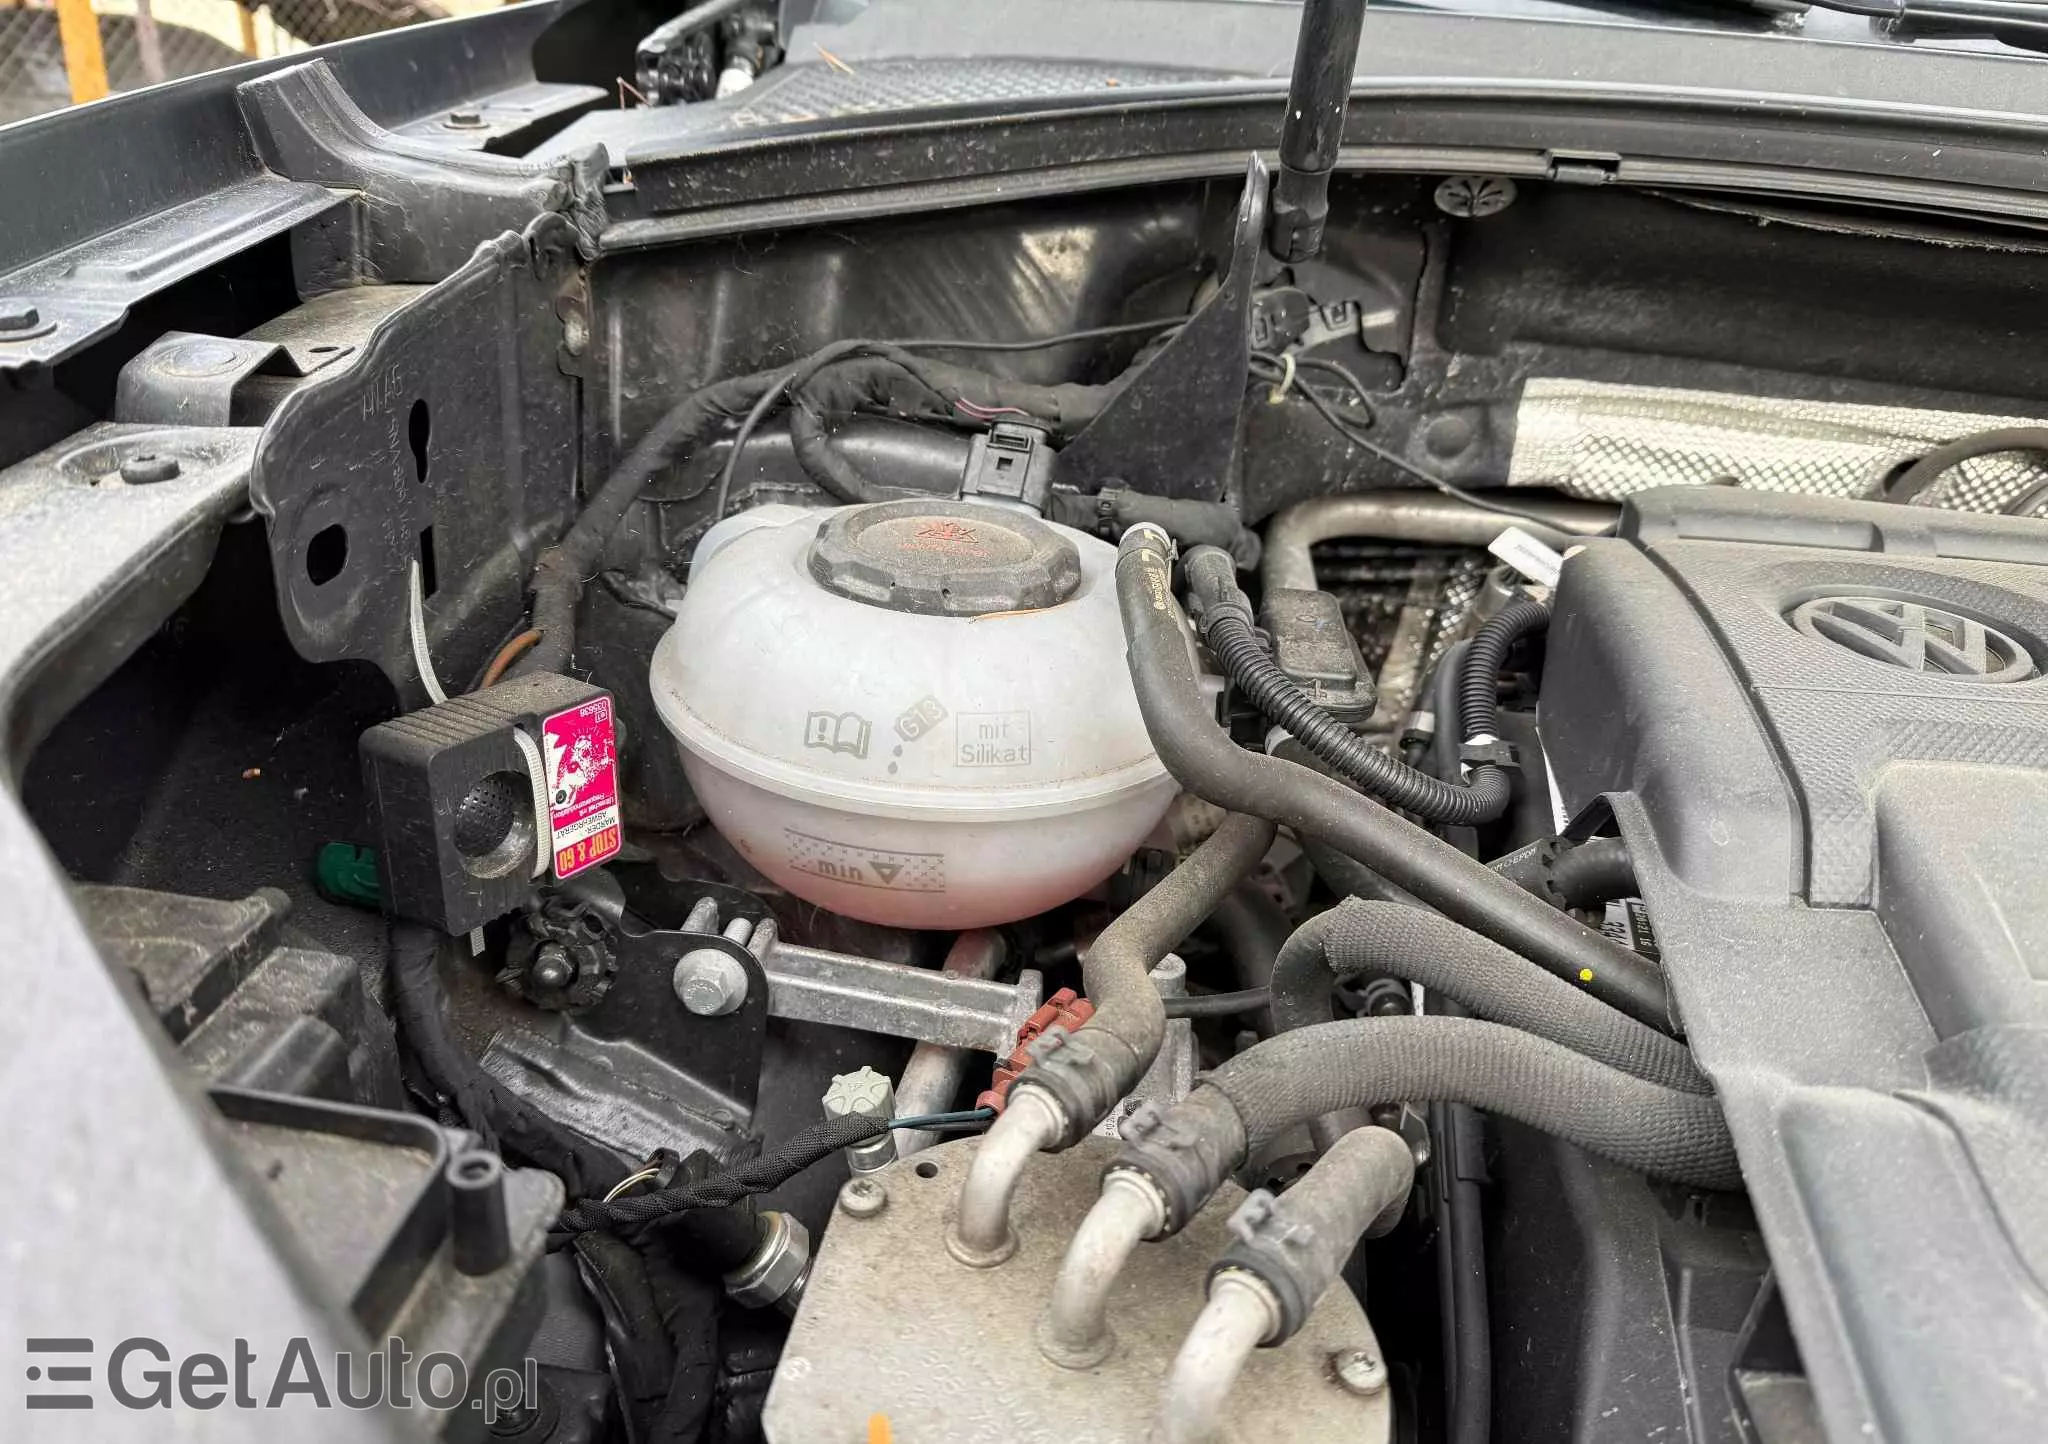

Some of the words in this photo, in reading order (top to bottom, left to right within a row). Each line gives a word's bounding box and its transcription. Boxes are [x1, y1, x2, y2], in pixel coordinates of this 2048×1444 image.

[899, 699, 941, 738] G13
[978, 716, 1009, 740] mit
[960, 743, 1028, 764] Silikat
[577, 841, 587, 862] &
[589, 827, 617, 858] STOP
[559, 847, 576, 872] GO
[818, 859, 864, 881] min
